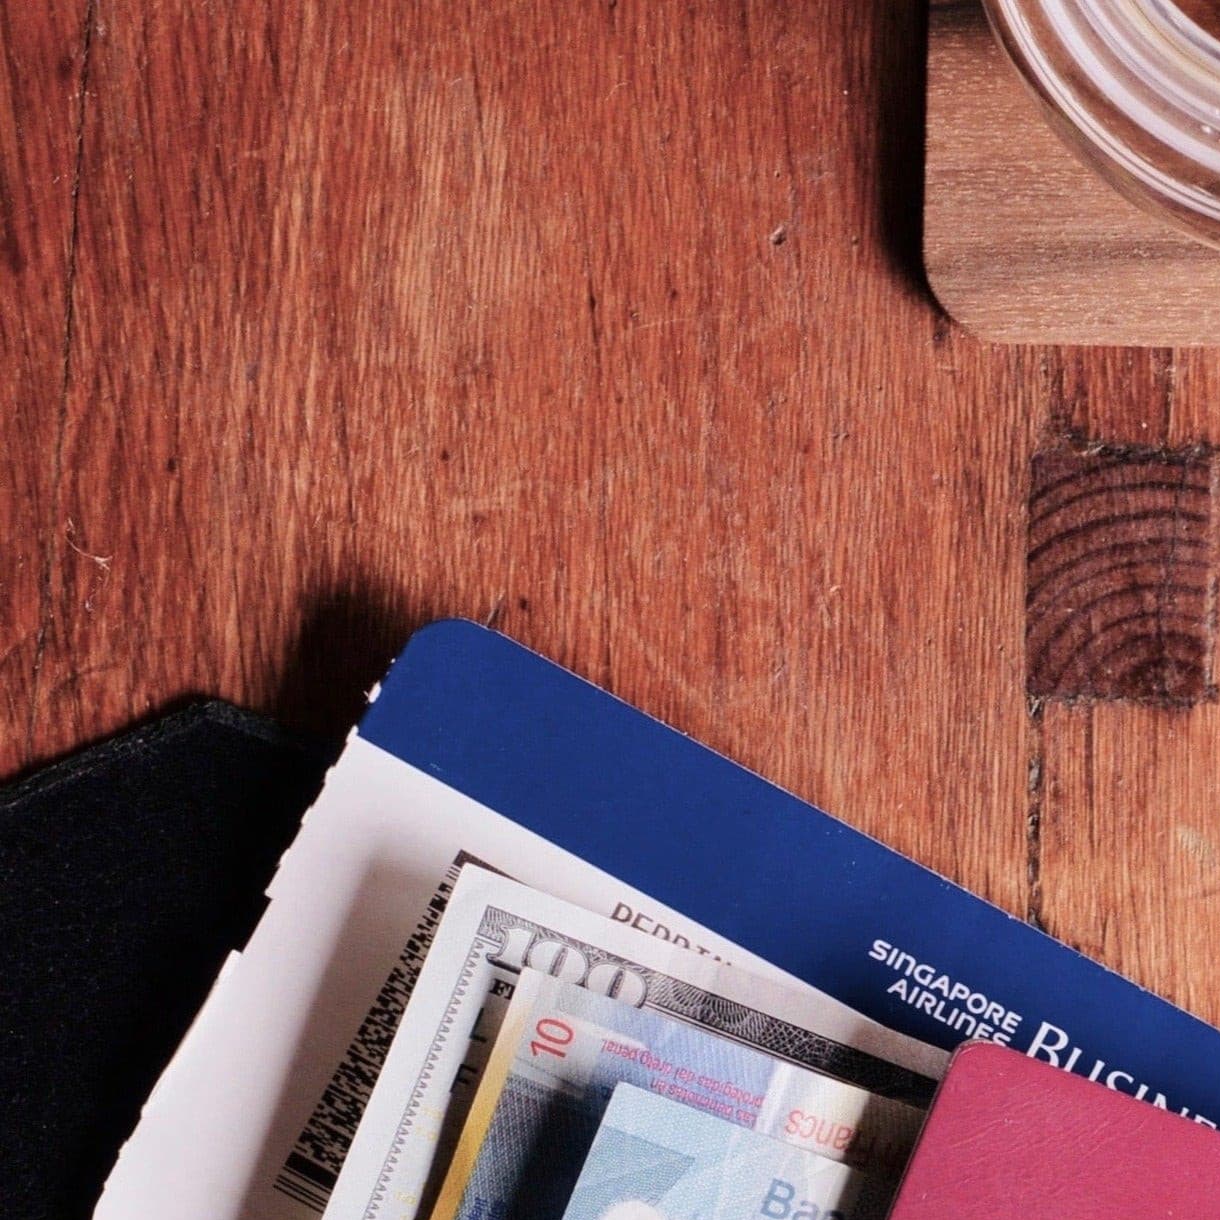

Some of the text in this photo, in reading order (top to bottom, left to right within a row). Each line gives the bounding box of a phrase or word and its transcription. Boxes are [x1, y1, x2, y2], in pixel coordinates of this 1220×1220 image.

[868, 938, 1023, 1034] SINGAPORE
[887, 978, 1012, 1047] AIRLINES
[530, 1018, 575, 1058] 10
